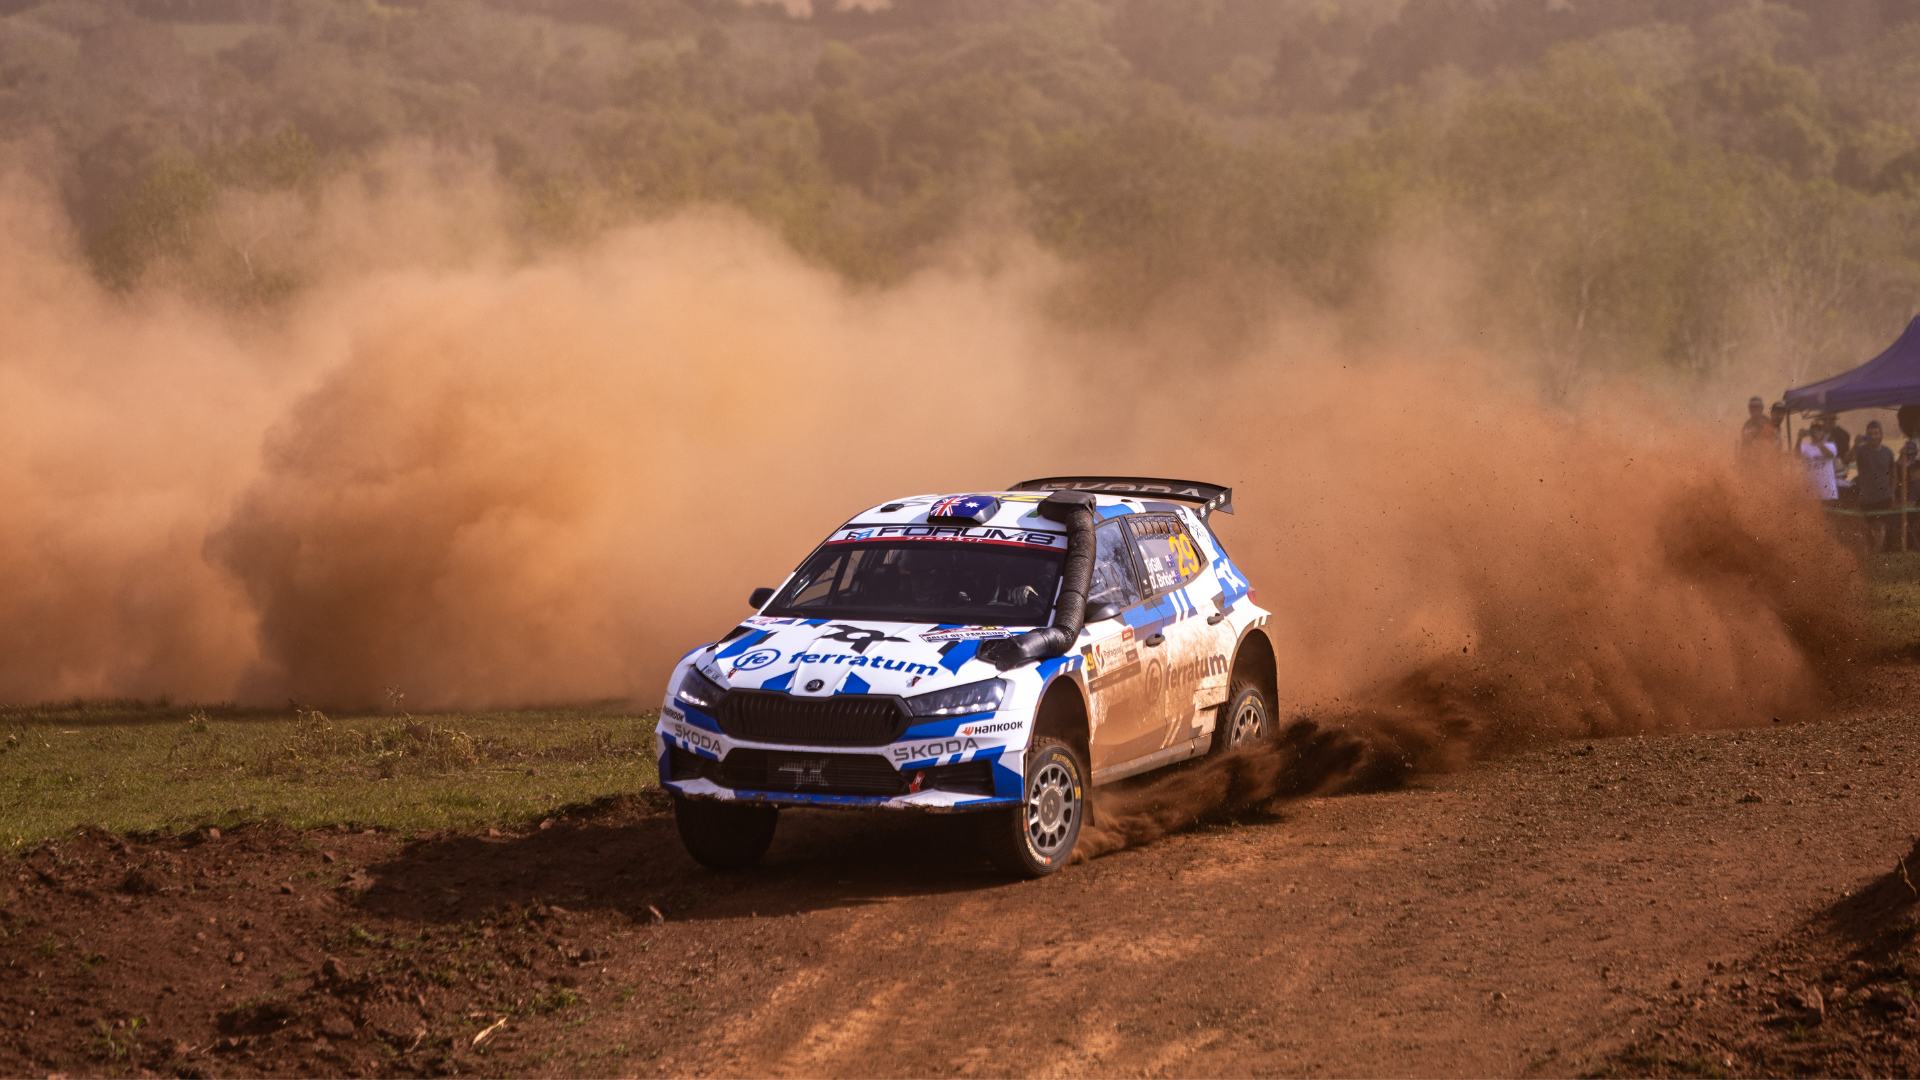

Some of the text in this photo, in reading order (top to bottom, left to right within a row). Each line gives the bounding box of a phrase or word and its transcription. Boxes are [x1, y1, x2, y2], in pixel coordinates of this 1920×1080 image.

[877, 526, 1056, 545] FORUM8
[1168, 533, 1199, 577] 29
[788, 651, 938, 676] ferratum
[1166, 654, 1228, 690] ferratum
[674, 724, 722, 754] SKODA
[893, 737, 979, 762] SKODA
